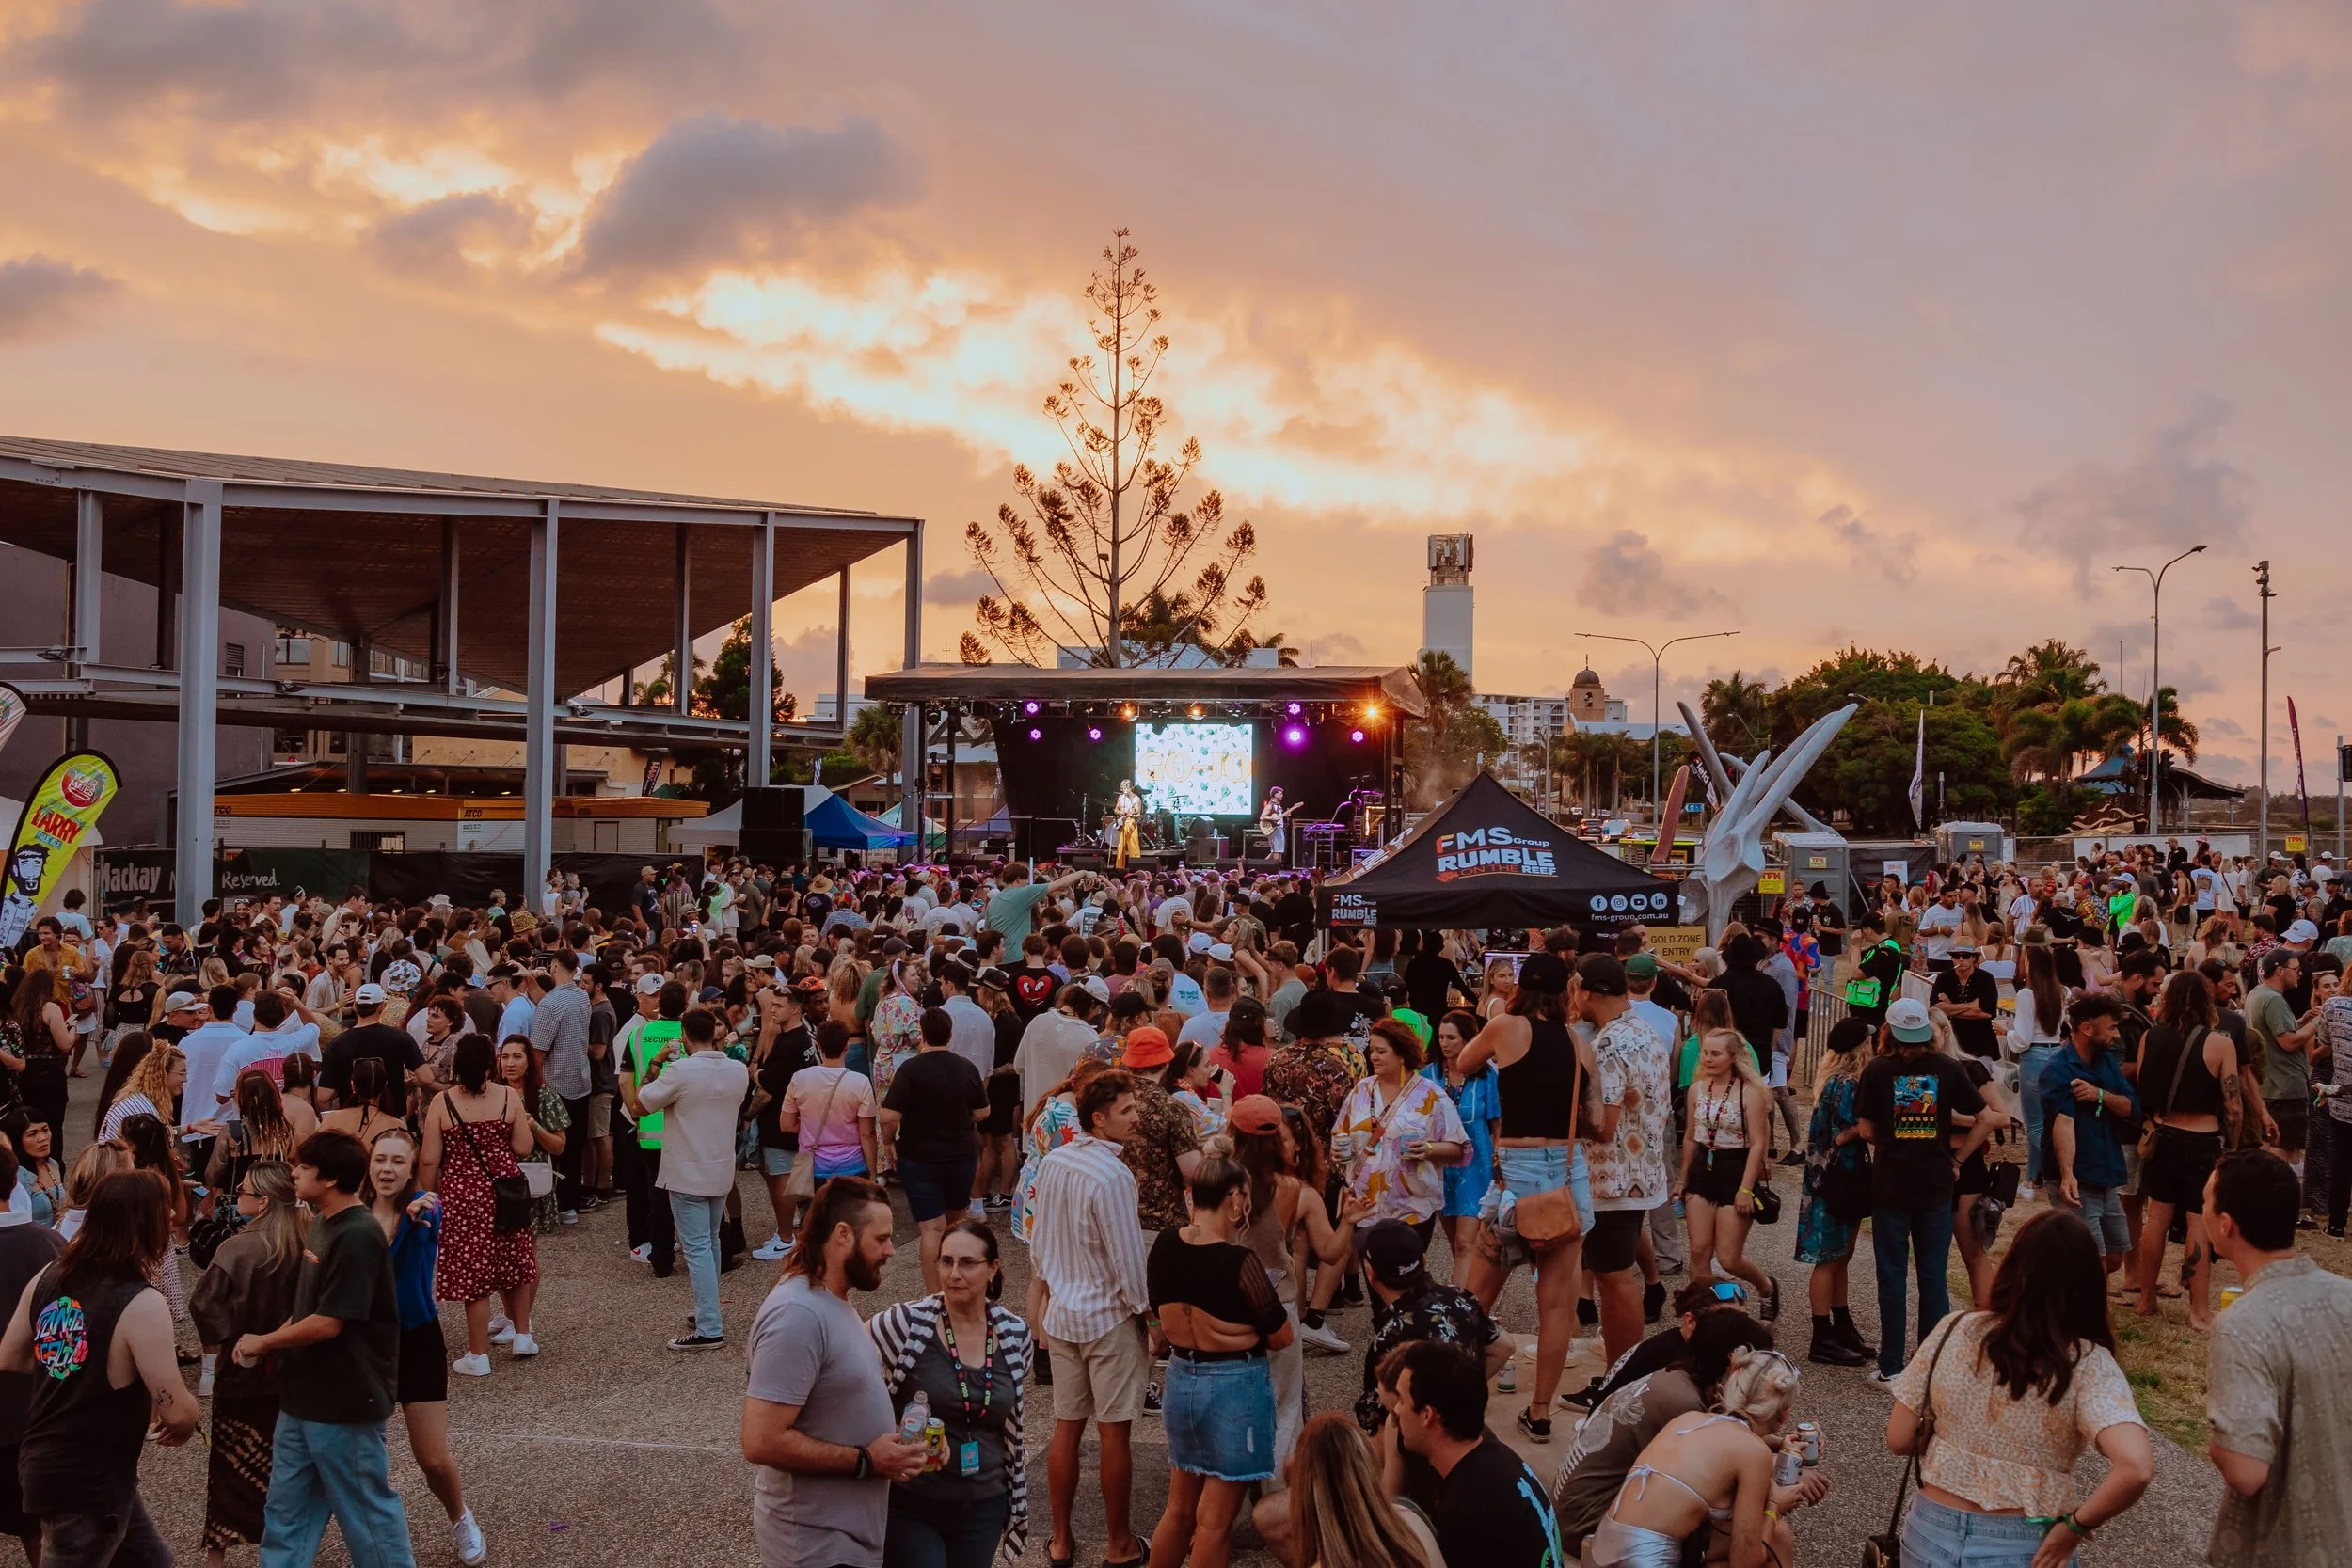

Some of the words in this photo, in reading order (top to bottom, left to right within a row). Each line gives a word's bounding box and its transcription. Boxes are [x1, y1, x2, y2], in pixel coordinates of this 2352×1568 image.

[1136, 752, 1252, 783] GO-JO
[73, 770, 98, 792] YOUR
[69, 780, 95, 798] MATES
[215, 805, 231, 815] TCO
[464, 809, 483, 818] ATCO
[30, 804, 82, 845] LARRY
[1436, 827, 1513, 854] FMS
[1513, 837, 1550, 847] Group
[1438, 847, 1555, 872] RUMBLE
[1460, 865, 1485, 876] ON
[1487, 863, 1518, 874] THE
[1521, 865, 1557, 876] REEF
[101, 862, 162, 894] Mackay
[1332, 894, 1362, 907] FMS
[1331, 907, 1377, 920] RUMBLE
[1591, 912, 1669, 923] fms-group.com.au
[1650, 935, 1676, 944] GOLD
[1677, 934, 1702, 943] ZONE
[1662, 947, 1691, 957] ENTRY
